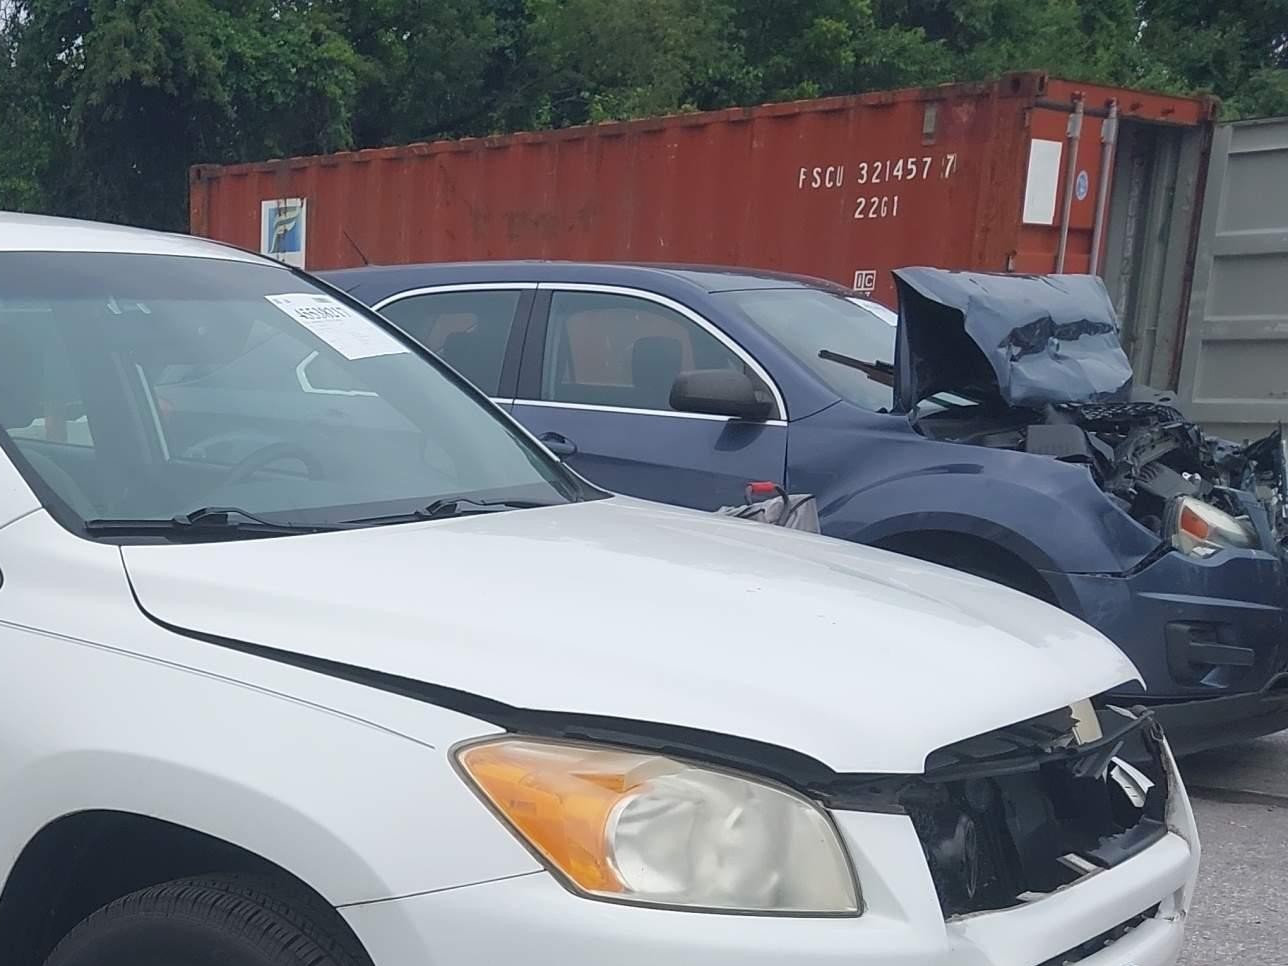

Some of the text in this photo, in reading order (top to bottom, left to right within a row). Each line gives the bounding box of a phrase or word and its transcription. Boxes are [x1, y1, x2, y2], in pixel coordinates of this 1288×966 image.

[799, 165, 844, 189] FSCU
[857, 156, 932, 184] 321457
[854, 195, 899, 219] 22G1
